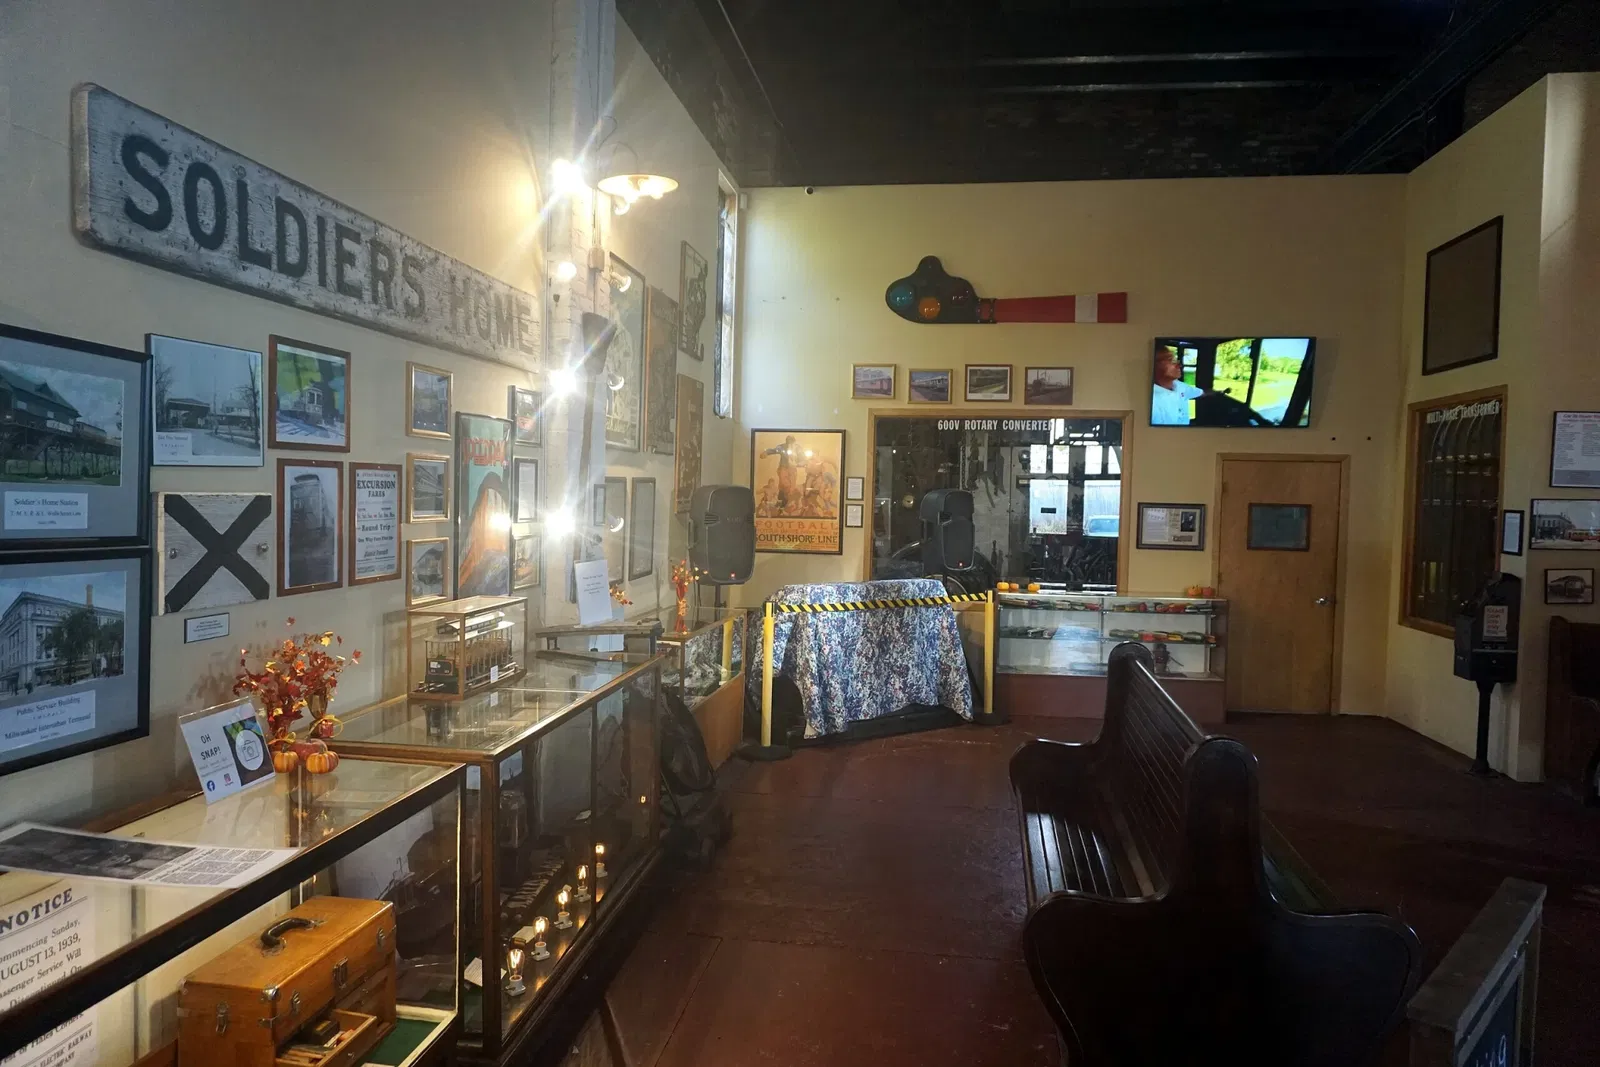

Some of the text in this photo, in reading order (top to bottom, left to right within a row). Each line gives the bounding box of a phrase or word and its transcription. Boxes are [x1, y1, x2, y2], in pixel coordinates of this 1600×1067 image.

[448, 272, 534, 355] HOME
[937, 419, 960, 431] 600V
[964, 419, 998, 431] ROTARY
[356, 480, 396, 490] EXCURSION
[367, 490, 386, 498] FARES
[379, 523, 391, 532] Trip
[786, 534, 815, 544] SHORE
[817, 535, 838, 544] LINE
[200, 733, 212, 744] OH
[200, 746, 222, 760] SNAP!
[0, 887, 73, 934] NOTICE
[0, 919, 81, 963] ommencing Sunday,
[1, 932, 81, 980] UGUST 13, 1939,
[0, 975, 35, 998] assenger
[37, 960, 64, 979] Service
[66, 947, 82, 961] Will
[67, 1028, 93, 1051] RAILWAY
